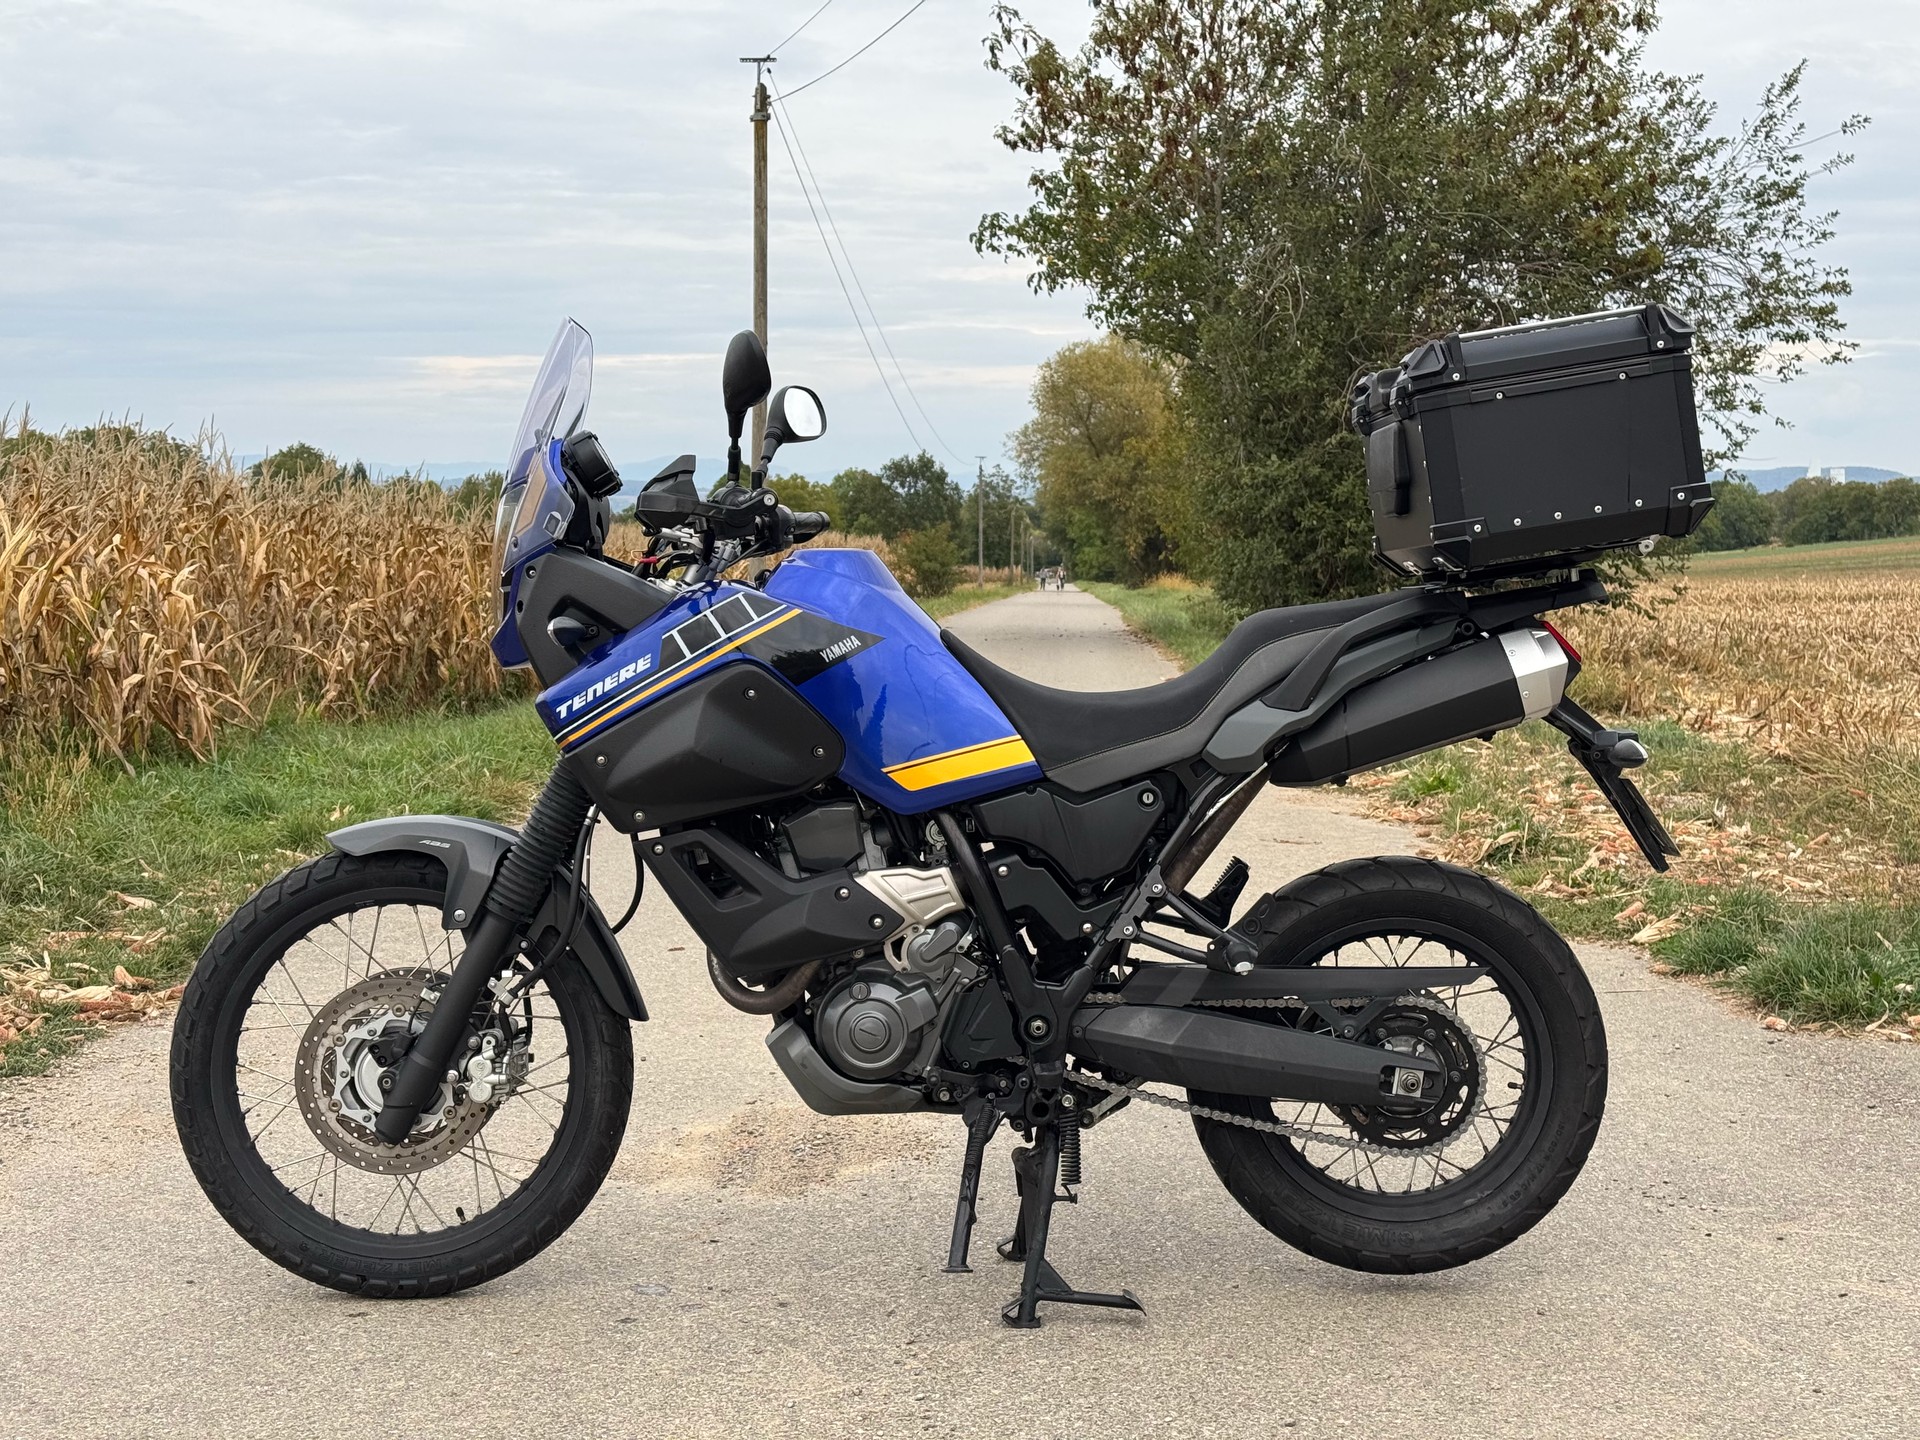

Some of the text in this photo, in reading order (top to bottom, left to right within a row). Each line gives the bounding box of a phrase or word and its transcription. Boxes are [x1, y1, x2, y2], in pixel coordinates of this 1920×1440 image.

[820, 635, 861, 663] YAMAHA
[556, 653, 652, 719] TENERE
[418, 839, 451, 848] ABS
[320, 1250, 442, 1275] METZELER
